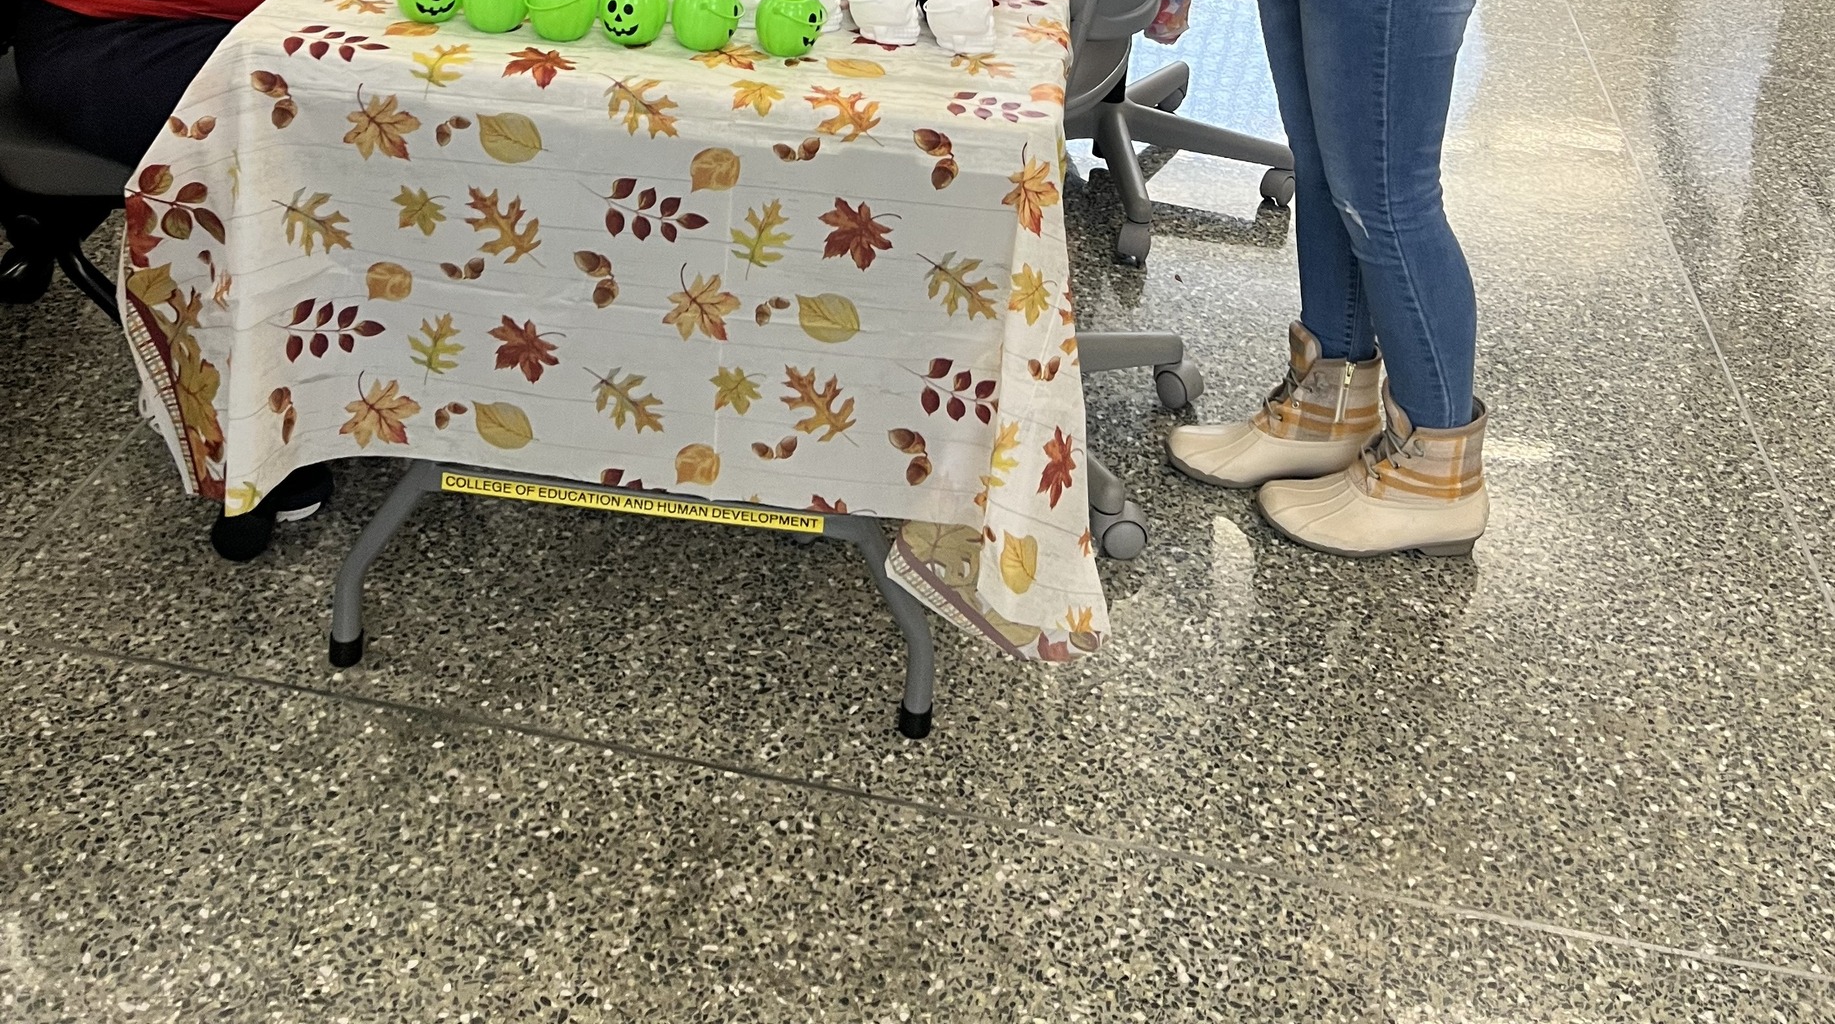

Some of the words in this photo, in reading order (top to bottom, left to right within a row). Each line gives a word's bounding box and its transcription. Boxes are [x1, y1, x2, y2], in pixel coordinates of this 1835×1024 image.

[446, 476, 512, 493] COLLEGE
[516, 484, 535, 496] OF
[538, 487, 620, 506] EDUCATION
[624, 498, 653, 510] AND
[657, 502, 708, 516] HUMAN
[712, 508, 818, 528] DEVELOPMENT
